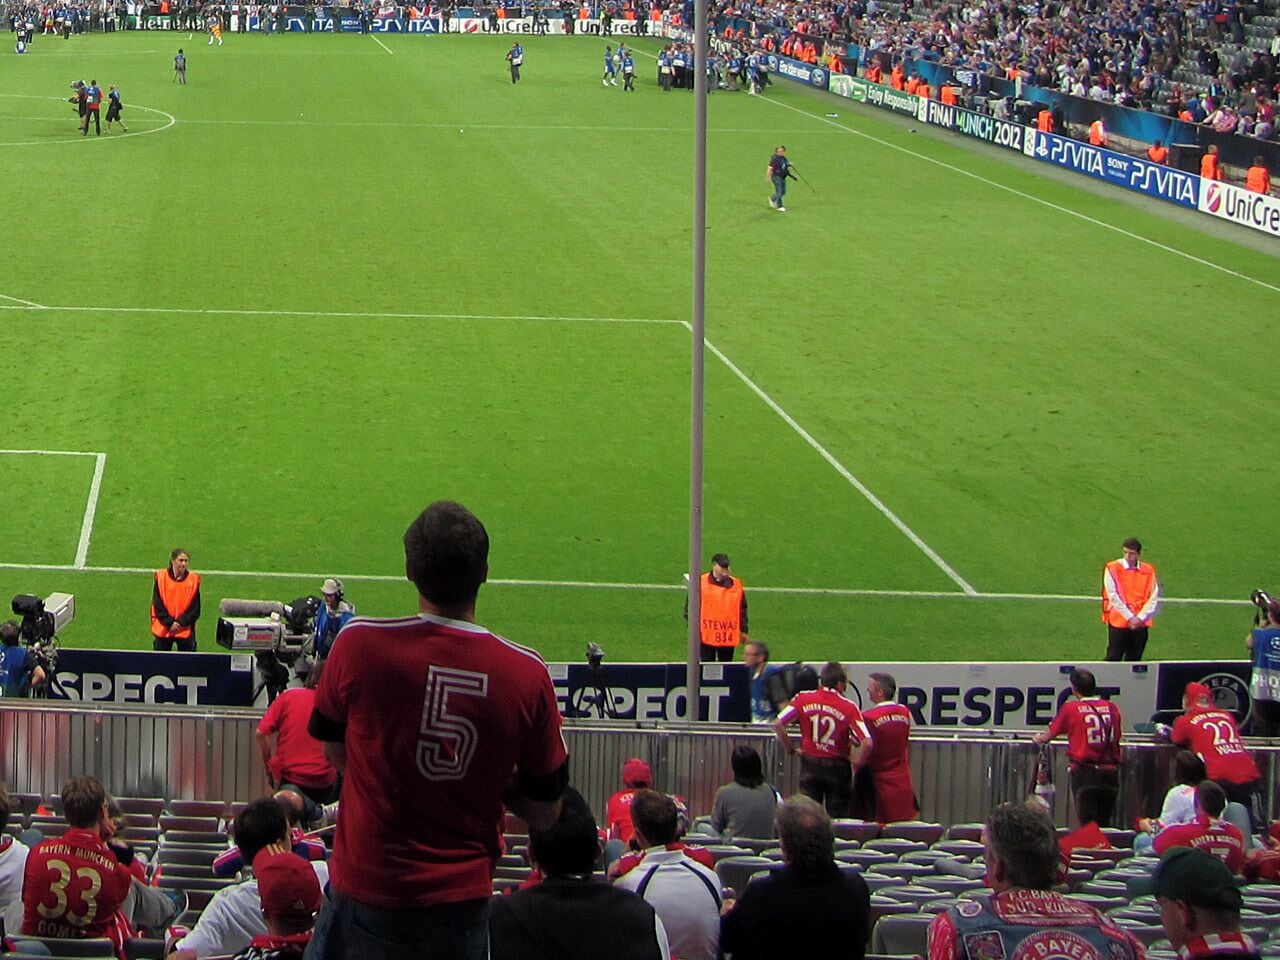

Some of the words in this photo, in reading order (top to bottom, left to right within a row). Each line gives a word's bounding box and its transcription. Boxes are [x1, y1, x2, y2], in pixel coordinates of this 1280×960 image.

[868, 85, 884, 106] Enjoy
[929, 102, 954, 128] FINAL
[956, 108, 993, 141] MUNICH
[994, 121, 1022, 151] 2012
[1107, 156, 1129, 172] SONY
[51, 671, 208, 706] SPECT
[556, 686, 730, 723] ESPECT
[415, 664, 489, 782] 5
[810, 714, 836, 745] 12
[1202, 720, 1239, 745] 22
[39, 845, 71, 857] BAYERN
[75, 847, 115, 872] MÜNCHEN
[36, 859, 103, 926] 33
